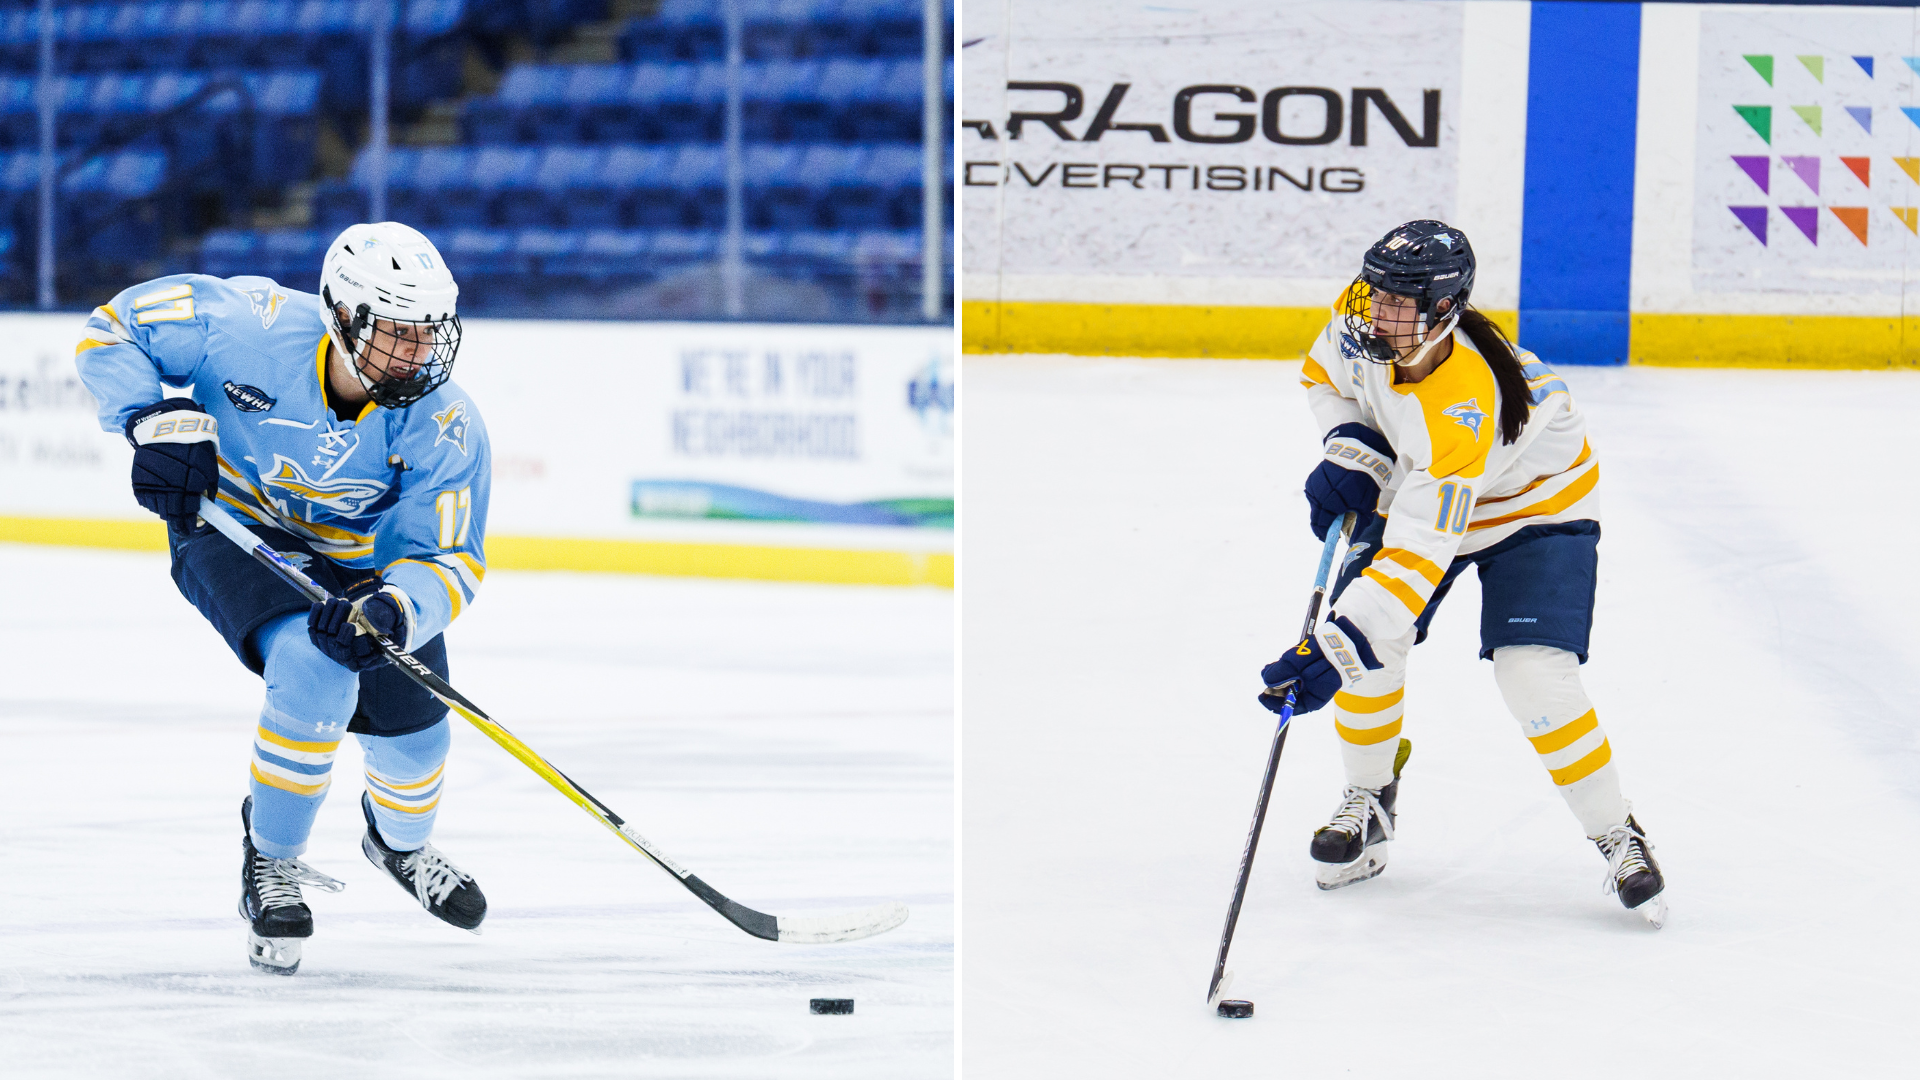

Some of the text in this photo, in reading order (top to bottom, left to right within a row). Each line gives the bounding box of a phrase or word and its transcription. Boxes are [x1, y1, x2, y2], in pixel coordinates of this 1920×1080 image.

[964, 161, 1365, 193] DVERTISING
[1385, 236, 1409, 250] 10
[415, 253, 434, 270] 17
[1433, 271, 1460, 281] BAUER
[339, 273, 365, 291] BAUER
[135, 284, 195, 325] 17
[224, 382, 272, 411] NEWHA
[152, 418, 218, 438] BAU
[436, 485, 471, 549] 17
[1434, 481, 1473, 535] 10
[376, 635, 432, 676] AUER
[1323, 632, 1363, 688] BAU
[624, 825, 655, 849] VICTORY
